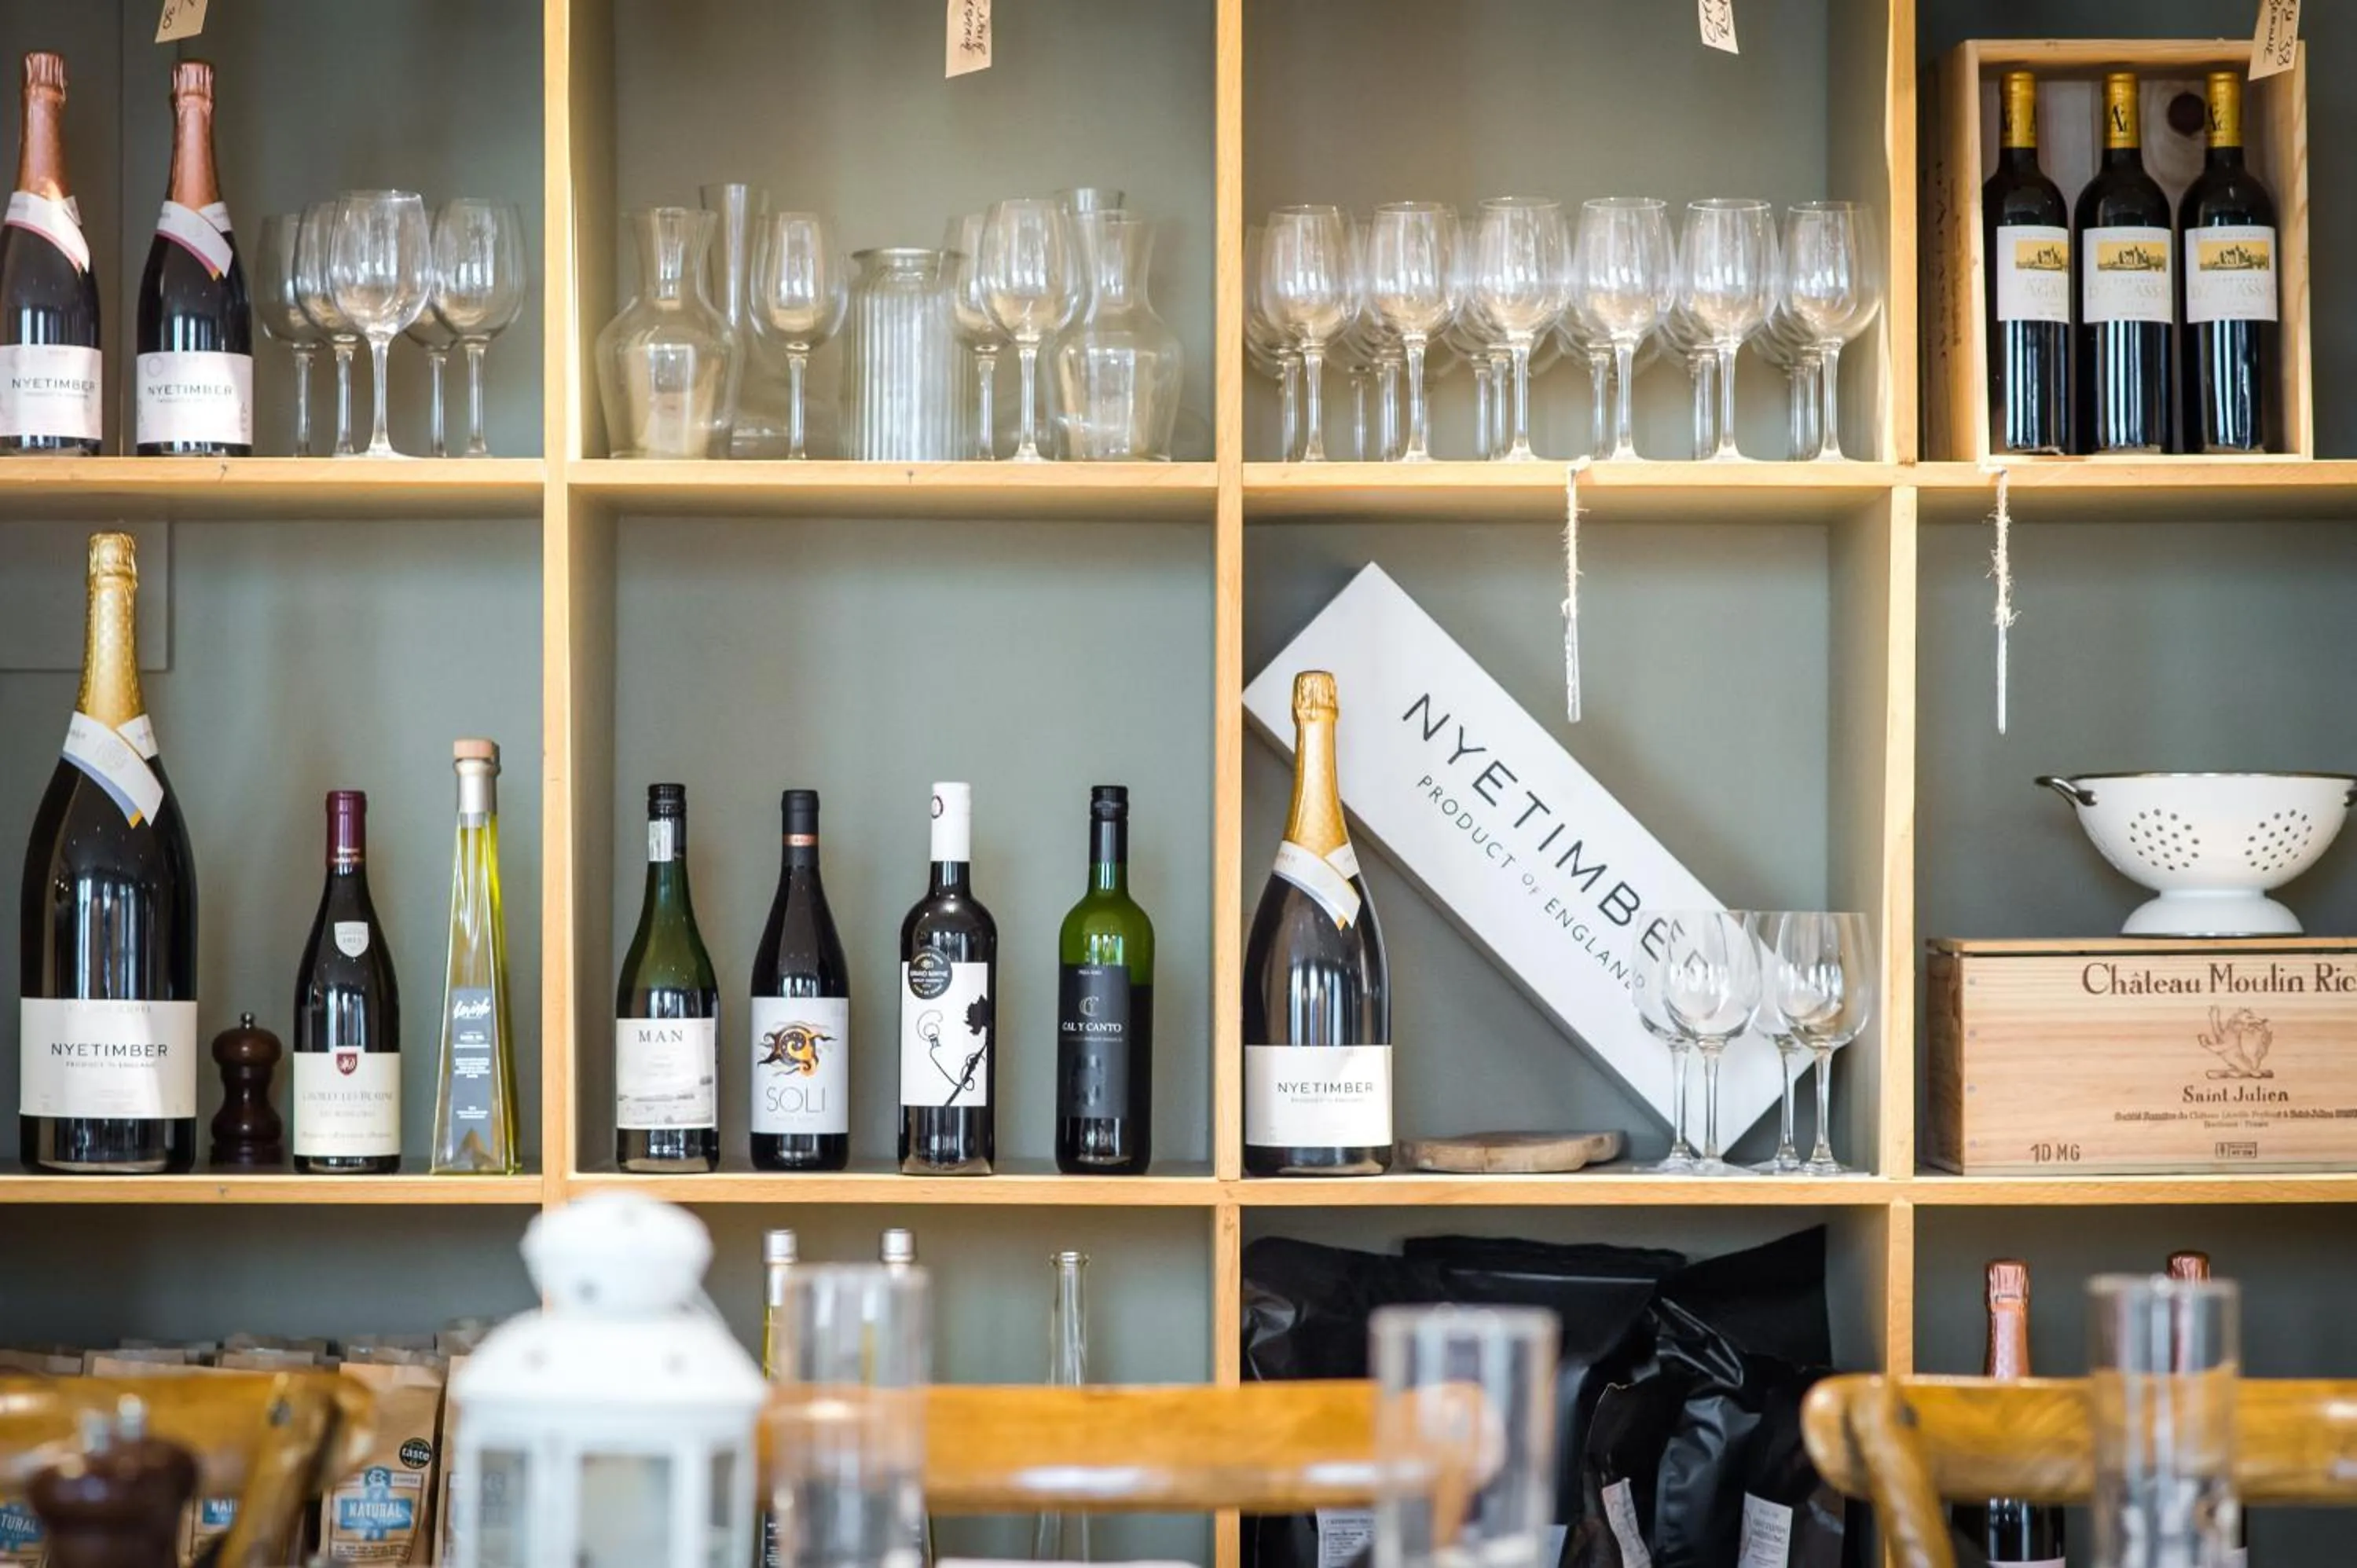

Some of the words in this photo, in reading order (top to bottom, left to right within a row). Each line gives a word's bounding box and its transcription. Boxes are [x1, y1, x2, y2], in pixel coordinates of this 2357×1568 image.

[12, 378, 96, 390] NYETIMBER
[148, 384, 233, 395] NYETIMBER
[1417, 775, 1516, 870] PRODUCT
[1521, 873, 1541, 896] OF
[2082, 962, 2200, 995] Château
[2209, 962, 2304, 993] Moulin
[1086, 1022, 1122, 1033] CANTO
[638, 1029, 683, 1043] MAN
[51, 1043, 168, 1057] NYETIMBER
[1277, 1082, 1373, 1094] NYETIMBER
[2233, 1085, 2289, 1102] Julien
[766, 1086, 826, 1112] SOLI
[401, 1447, 430, 1462] taste
[348, 1501, 402, 1519] NATURAL
[1, 1513, 35, 1533] TURAL
